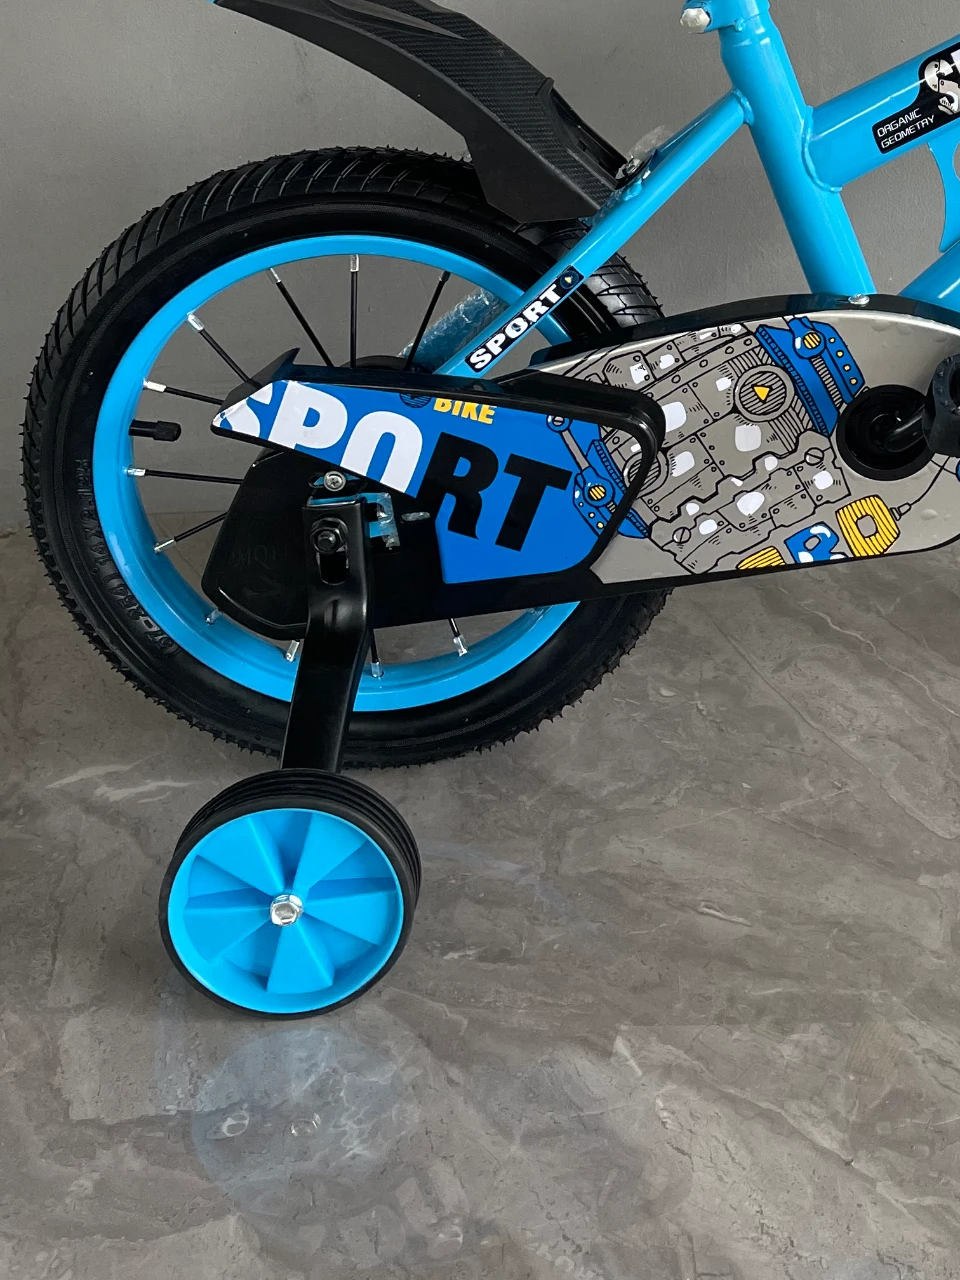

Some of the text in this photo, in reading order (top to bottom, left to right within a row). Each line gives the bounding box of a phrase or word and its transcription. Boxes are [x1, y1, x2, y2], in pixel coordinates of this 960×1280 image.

[877, 108, 922, 137] ORGANIC
[880, 115, 935, 149] GEOMETRY
[468, 284, 563, 372] SPORT
[433, 397, 498, 425] BIKE
